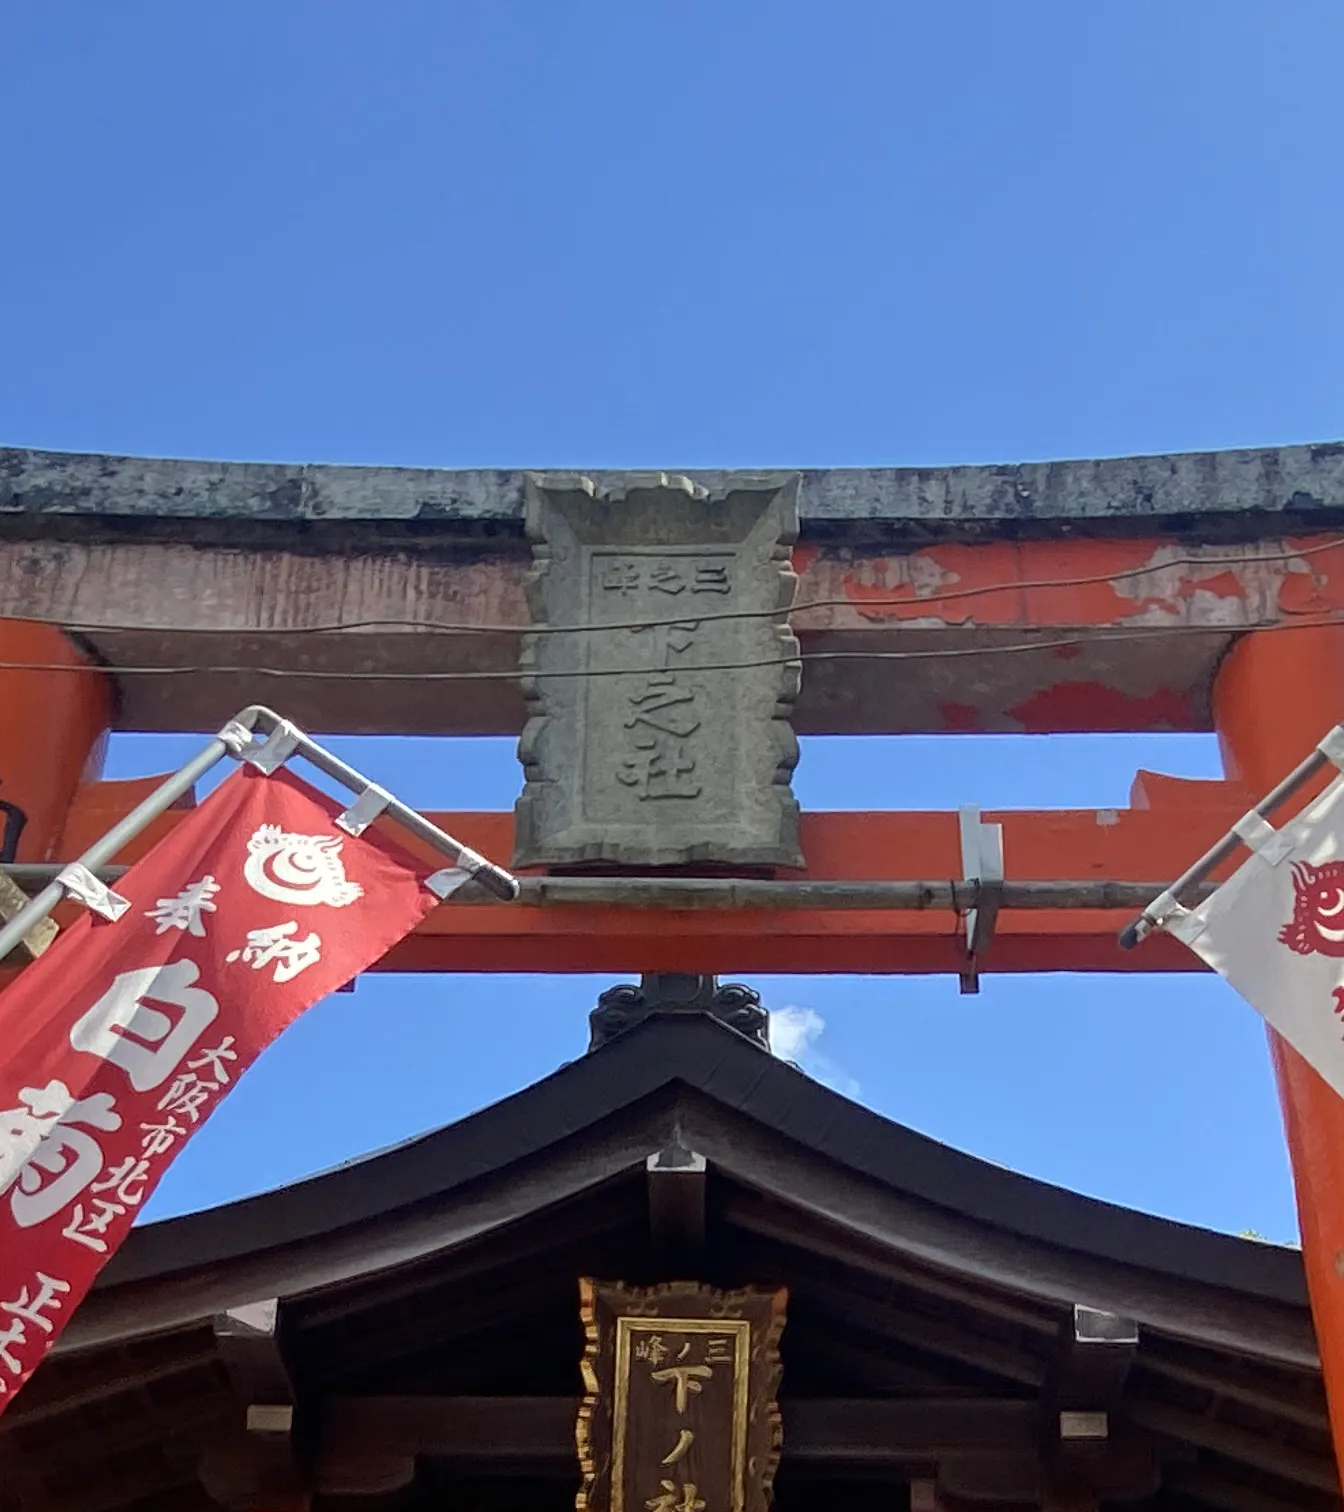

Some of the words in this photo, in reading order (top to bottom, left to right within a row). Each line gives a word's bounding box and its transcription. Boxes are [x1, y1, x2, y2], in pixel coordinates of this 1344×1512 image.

[144, 876, 322, 983] 奉納
[62, 1036, 240, 1253] 大阪市北区
